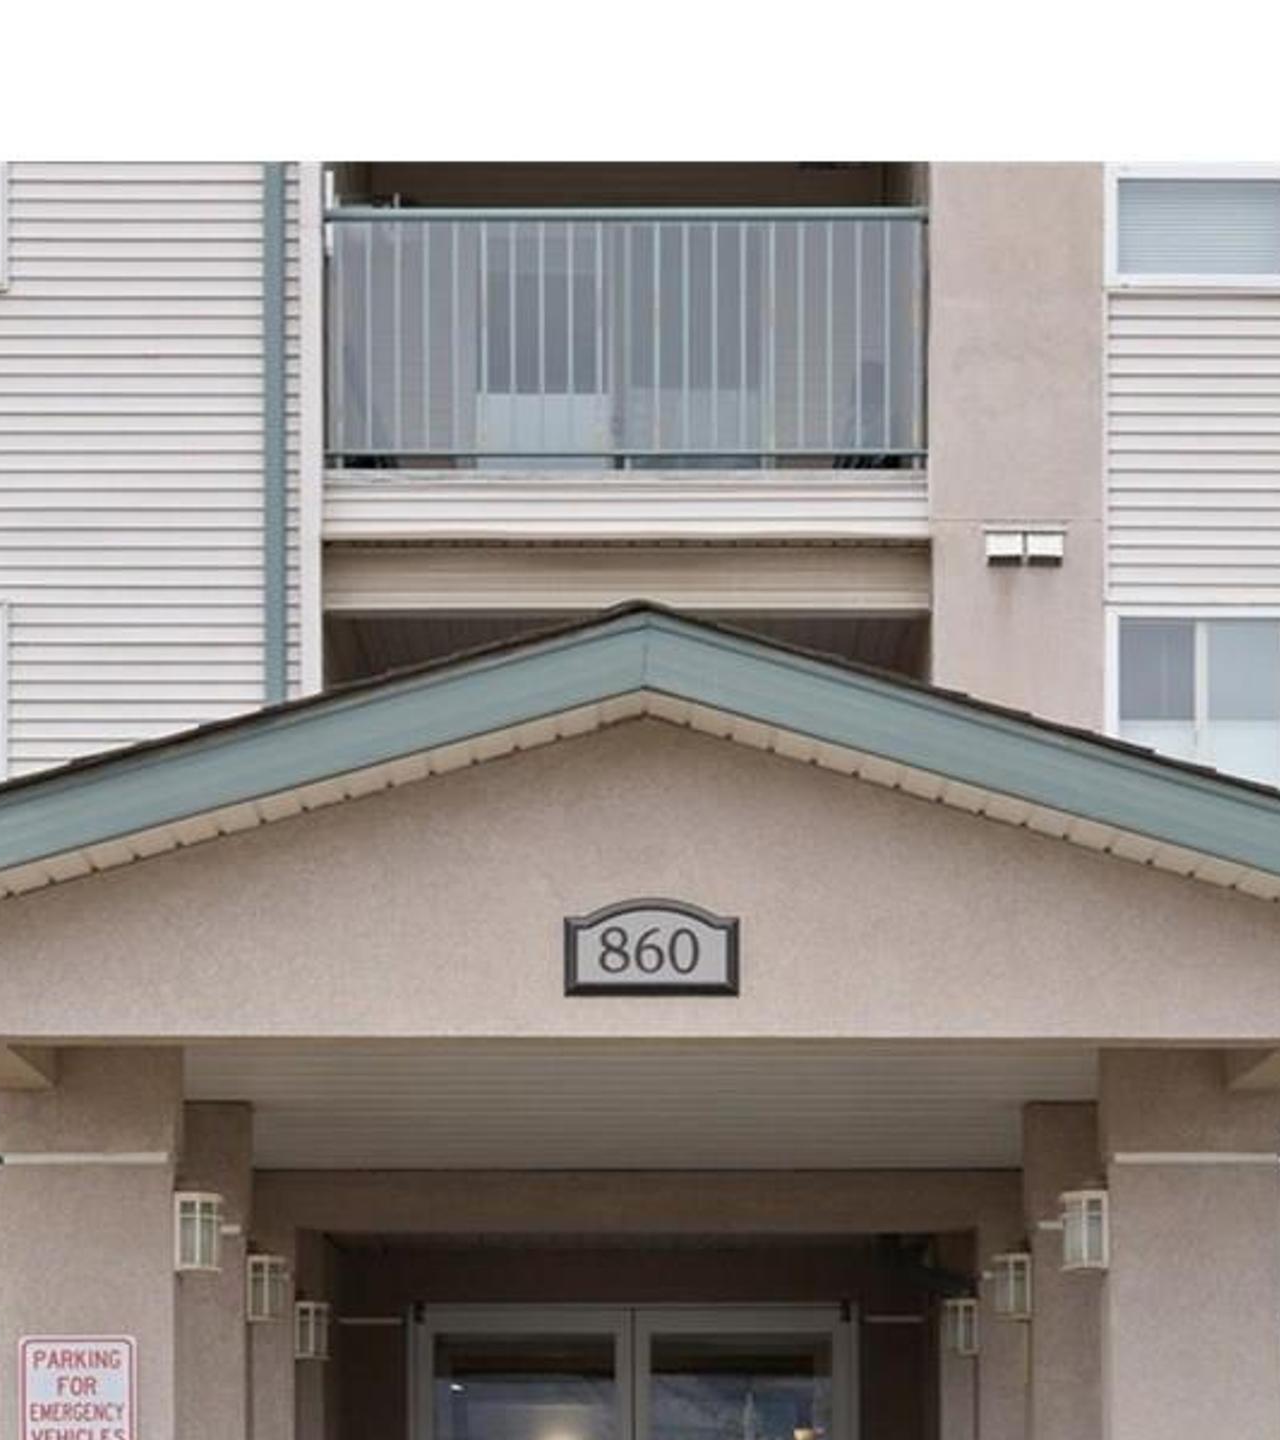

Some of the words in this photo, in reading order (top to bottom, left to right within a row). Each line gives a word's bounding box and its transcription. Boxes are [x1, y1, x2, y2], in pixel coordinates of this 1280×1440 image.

[598, 926, 701, 974] 860
[32, 1350, 122, 1370] PARKING
[57, 1376, 97, 1396] FOR
[30, 1403, 125, 1422] EMERGENCY
